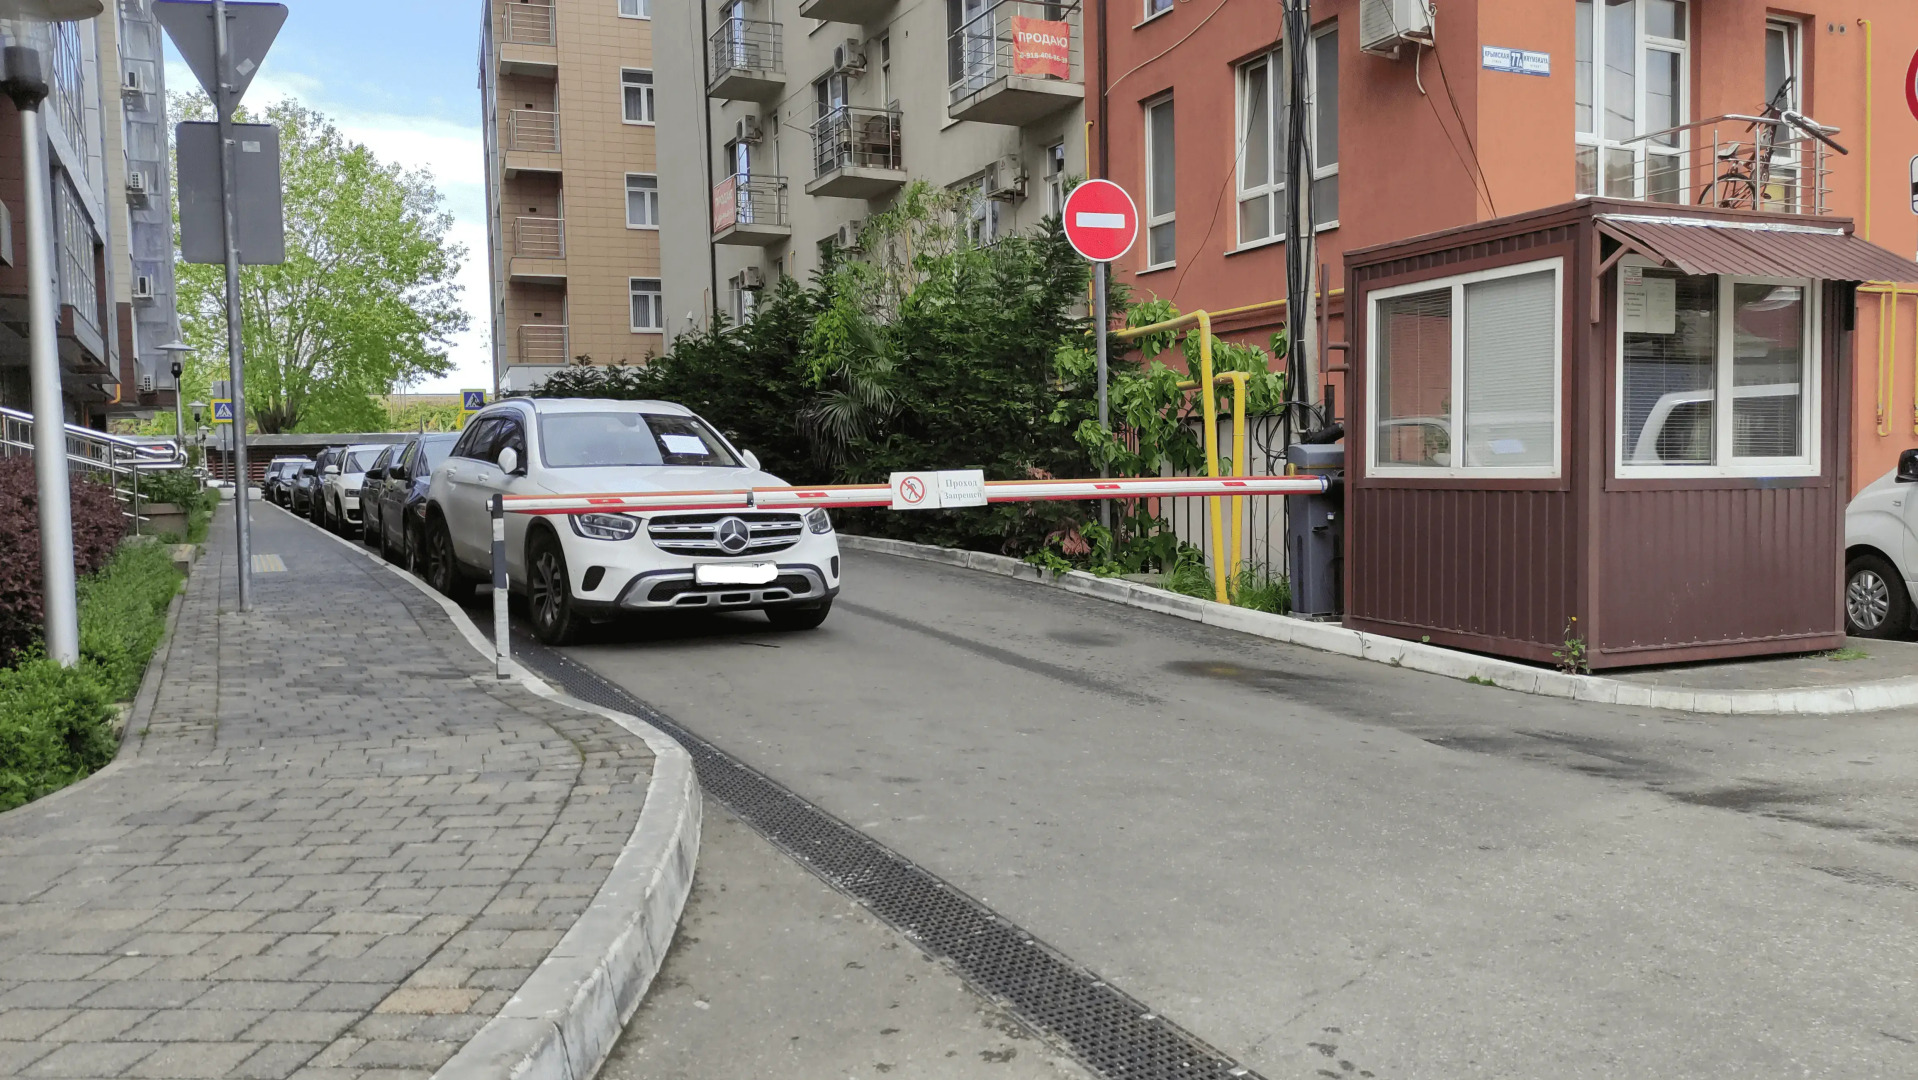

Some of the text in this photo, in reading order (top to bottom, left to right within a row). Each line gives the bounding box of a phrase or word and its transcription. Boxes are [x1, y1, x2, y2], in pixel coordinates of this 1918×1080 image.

[1018, 31, 1067, 47] ПРОДАЮ
[1484, 50, 1510, 59] КРЫМСКАЯ
[945, 479, 978, 489] Проход
